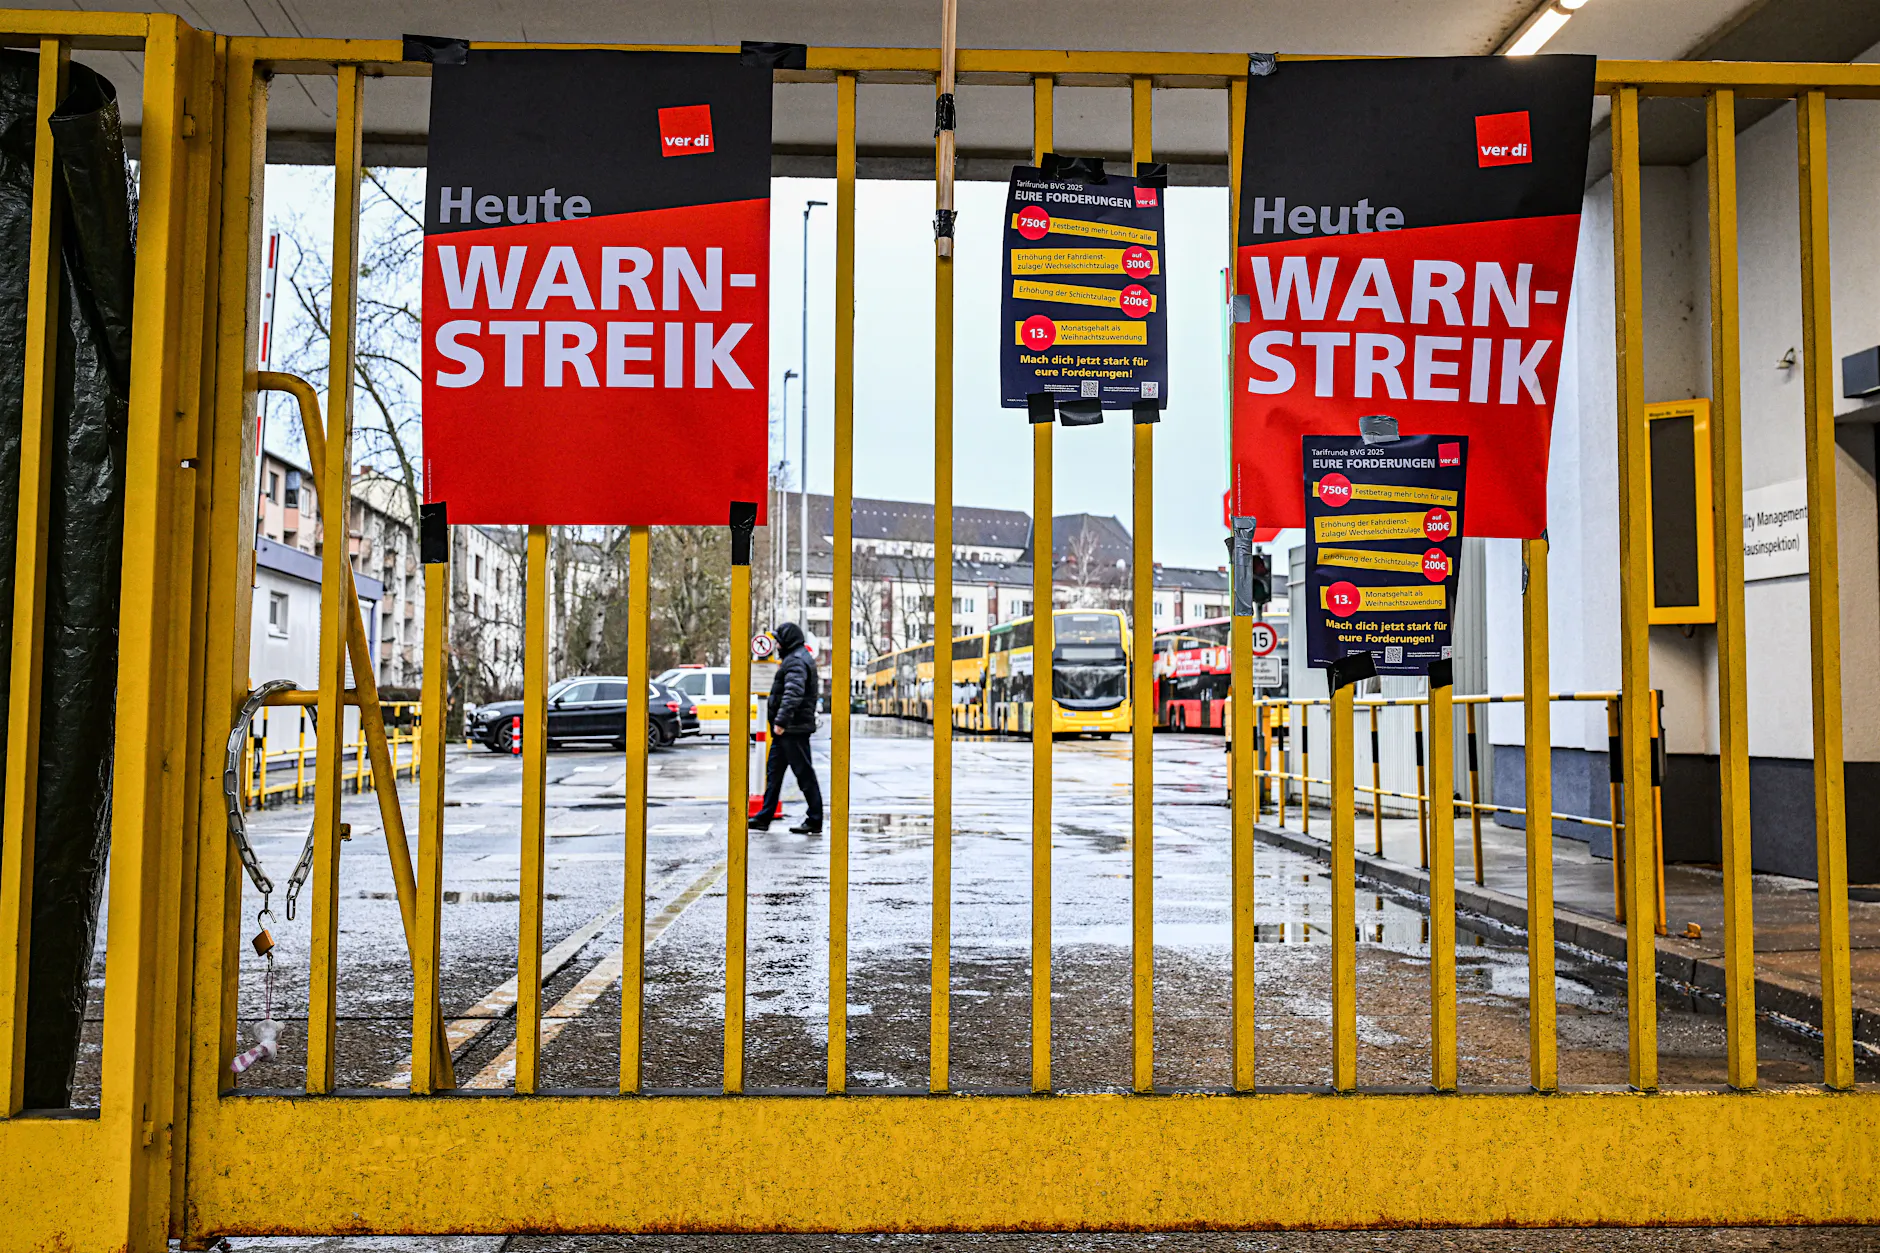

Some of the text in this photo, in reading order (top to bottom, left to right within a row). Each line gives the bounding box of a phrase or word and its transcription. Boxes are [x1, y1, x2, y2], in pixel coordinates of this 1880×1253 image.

[665, 134, 710, 147] ver.di
[1481, 142, 1527, 158] ver.di
[1016, 180, 1048, 190] Tarifrunde
[1014, 190, 1132, 208] EURE FORDERUNGEN
[439, 186, 592, 224] Heute
[1252, 197, 1404, 234] Heute
[1020, 218, 1046, 229] 750€
[1052, 222, 1152, 241] Festbetrag mehr Lohn für alle
[1017, 253, 1052, 261] Erhöhung
[1017, 262, 1119, 271] zulage/ Wechselschichtzulage
[1126, 260, 1151, 269] 300€
[437, 245, 756, 311] WARN-
[1019, 286, 1116, 302] Erhöhung der Schichtzulage
[1251, 256, 1558, 328] WARN-
[1123, 296, 1149, 307] 200€
[1029, 328, 1048, 339] 13.
[1061, 325, 1110, 333] Monatsgehalt
[1061, 334, 1142, 342] Weihnachtszuwendung
[435, 320, 754, 390] STREIK
[1020, 355, 1148, 366] Mach dich jetzt stark für
[1248, 330, 1552, 405] STREIK
[1035, 368, 1133, 380] eure Forderungen!
[1367, 448, 1384, 456] 2025
[1312, 458, 1435, 469] EURE FORDERUNGEN
[1322, 485, 1348, 495] 750€
[1356, 488, 1392, 498] Festbetrag
[1394, 490, 1412, 498] mehr
[1414, 492, 1429, 500] Lohn
[1757, 505, 1808, 527] Management
[1320, 520, 1356, 529] Erhöhung
[1370, 518, 1409, 526] Fahrdienst-
[1427, 522, 1450, 531] 300€
[1321, 527, 1420, 538] zulage/ Wechselschichtzulage
[1323, 554, 1358, 562] Erhöhung
[1374, 557, 1419, 567] Schichtzulage
[1424, 560, 1446, 570] 200€
[1334, 594, 1352, 605] 13.
[1365, 599, 1442, 607] Weihnachtszuwendung
[1326, 619, 1447, 633] Mach dich jetzt stark für
[1253, 632, 1268, 648] 15
[1338, 634, 1434, 645] eure Forderungen!
